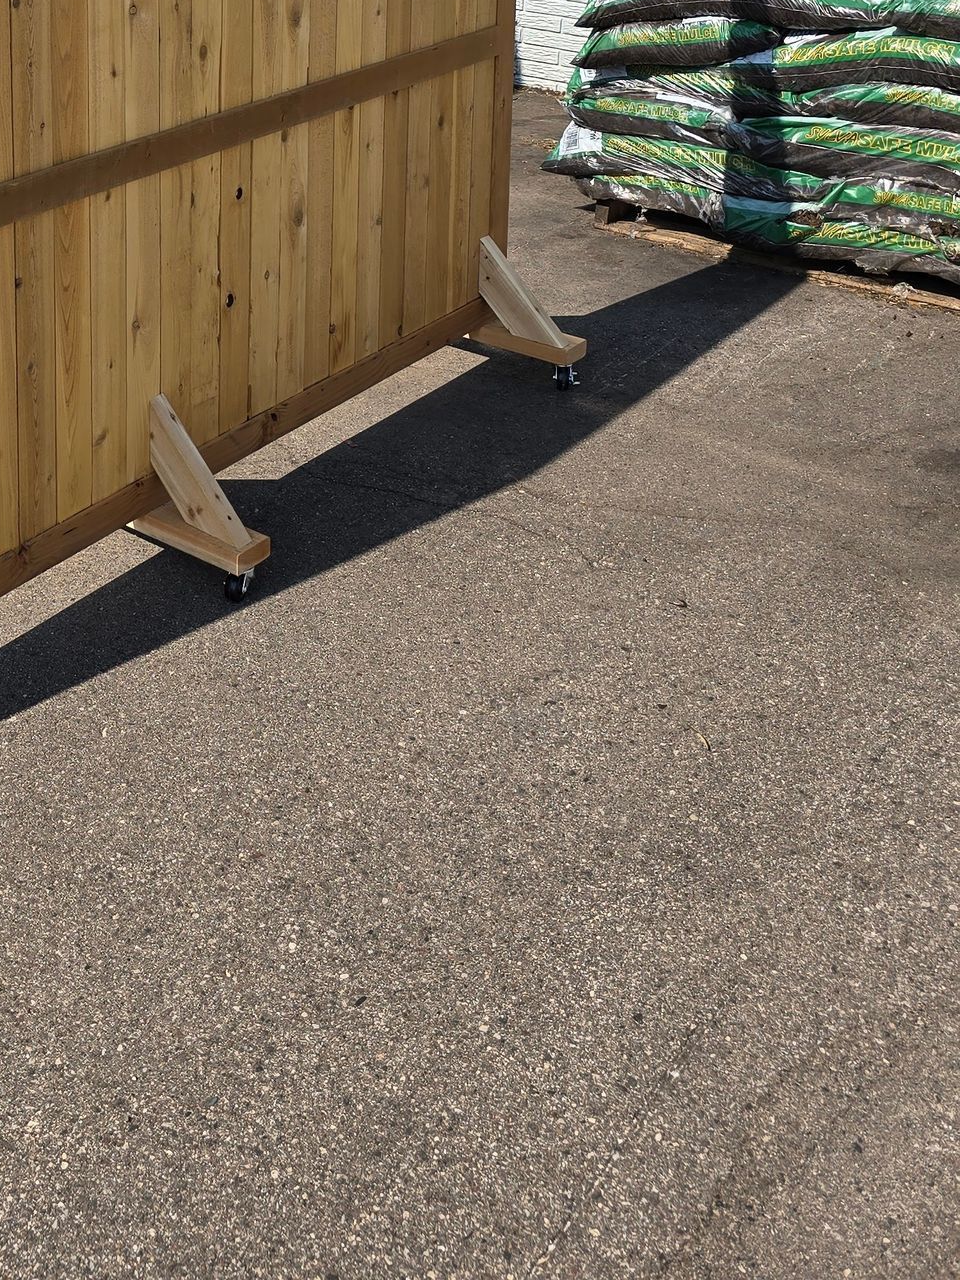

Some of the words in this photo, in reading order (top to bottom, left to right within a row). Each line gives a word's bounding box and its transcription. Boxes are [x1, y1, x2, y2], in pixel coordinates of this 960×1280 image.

[678, 26, 720, 41] MULCH
[777, 41, 876, 62] SYLVASAFE
[879, 38, 955, 61] MULCH
[650, 104, 688, 122] MULCH
[805, 126, 912, 153] SYLVASAFE
[873, 192, 943, 211] SYLVASAFE
